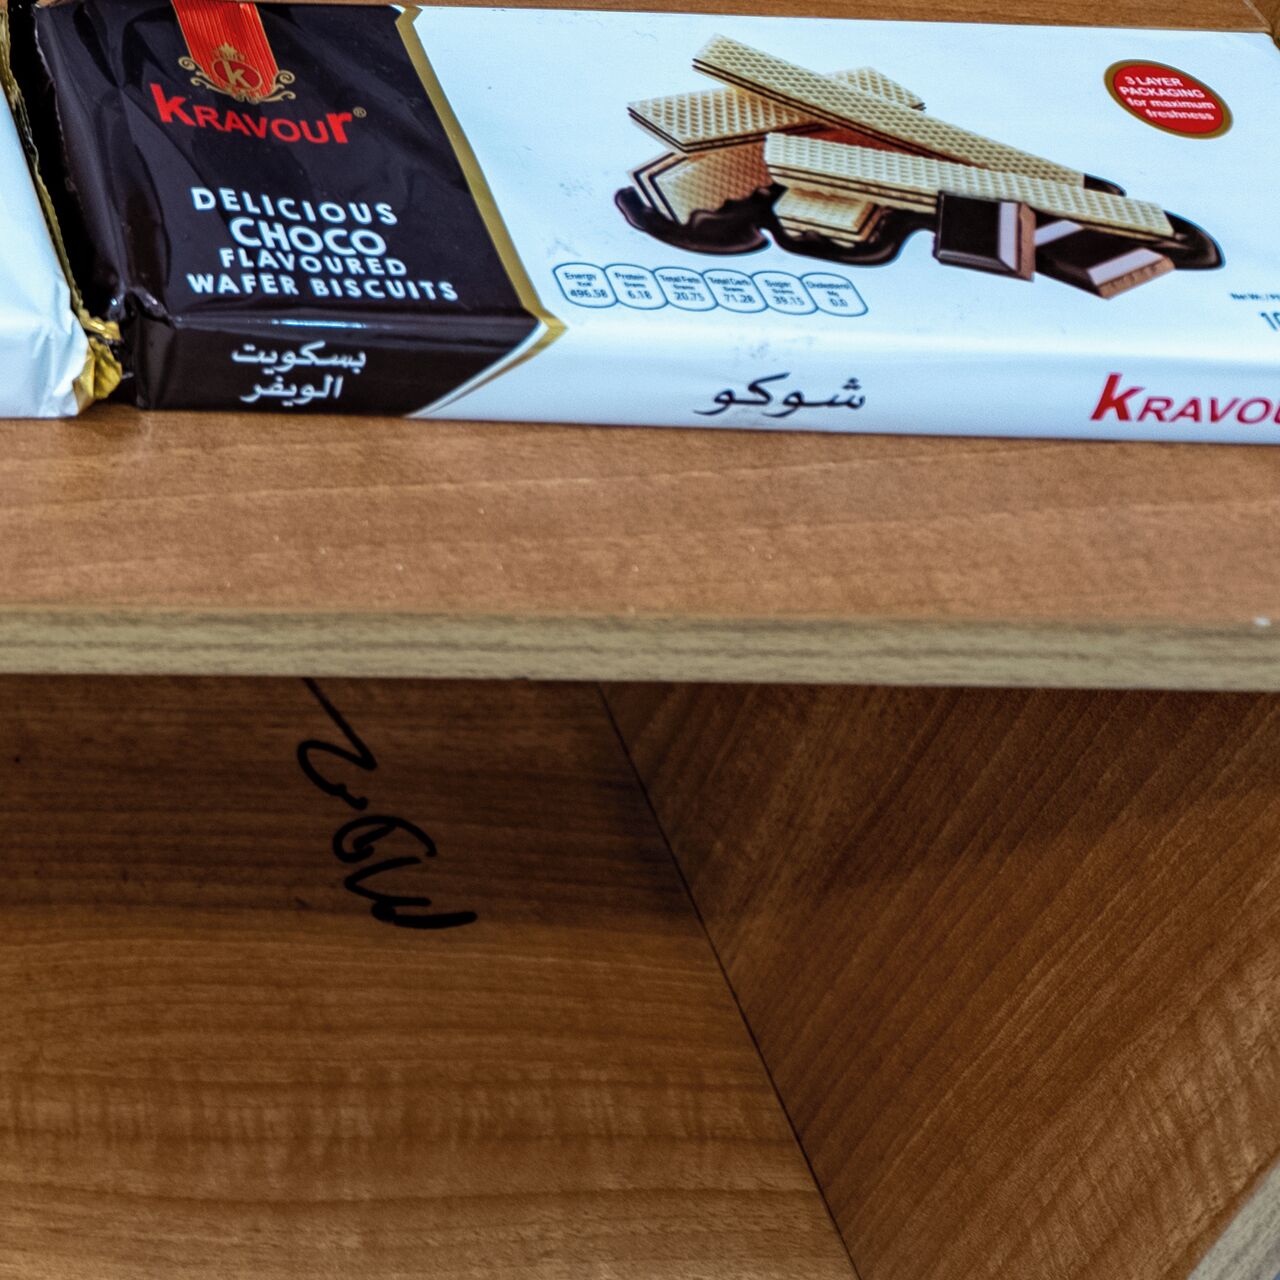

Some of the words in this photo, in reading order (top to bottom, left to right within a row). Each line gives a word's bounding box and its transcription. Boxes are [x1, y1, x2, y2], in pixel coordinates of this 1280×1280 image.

[1119, 86, 1205, 98] PACKAGING
[1124, 76, 1135, 85] 3
[1136, 76, 1183, 87] LAYER
[1126, 97, 1147, 107] for
[1150, 99, 1216, 109] maximum
[1145, 109, 1215, 120] freshness
[190, 187, 397, 225] DELICIOUS
[229, 218, 387, 257] CHOCO
[219, 248, 407, 277] FLAVOURED
[187, 273, 299, 297] WAFER
[313, 276, 459, 302] BISCUITS
[231, 340, 367, 374] بسكويت
[240, 375, 344, 407] الويفر
[693, 372, 867, 416] شوكو
